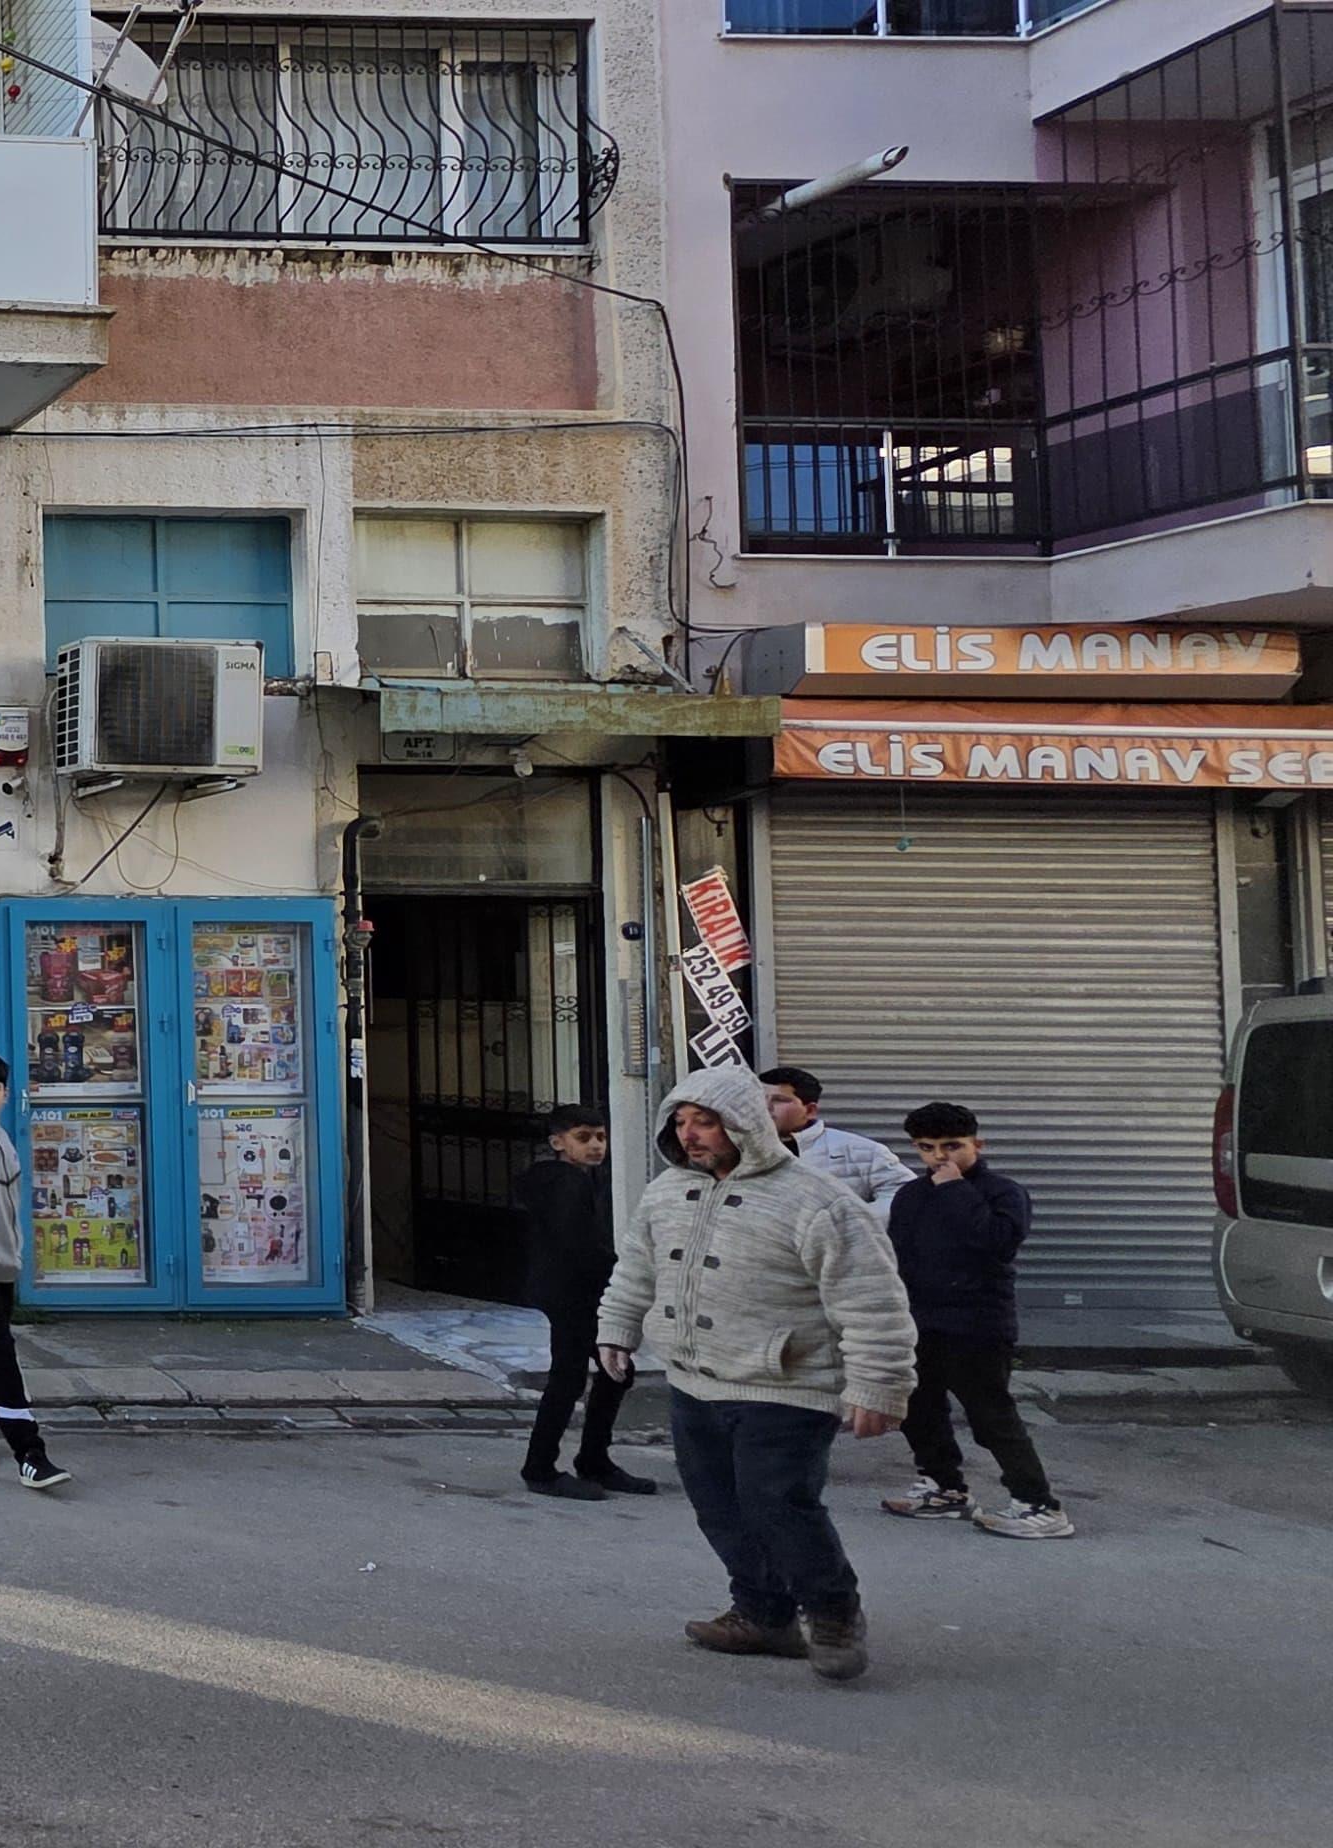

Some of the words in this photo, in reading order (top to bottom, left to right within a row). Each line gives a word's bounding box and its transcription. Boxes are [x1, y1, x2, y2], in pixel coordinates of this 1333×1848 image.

[861, 626, 994, 671] ELİS
[1018, 632, 1270, 671] MANAV
[403, 737, 436, 748] APT.
[817, 734, 945, 778] ELİS
[966, 744, 1207, 782] MANAV
[683, 946, 721, 987] 252
[705, 982, 734, 1010] 49
[718, 1005, 749, 1034] 59
